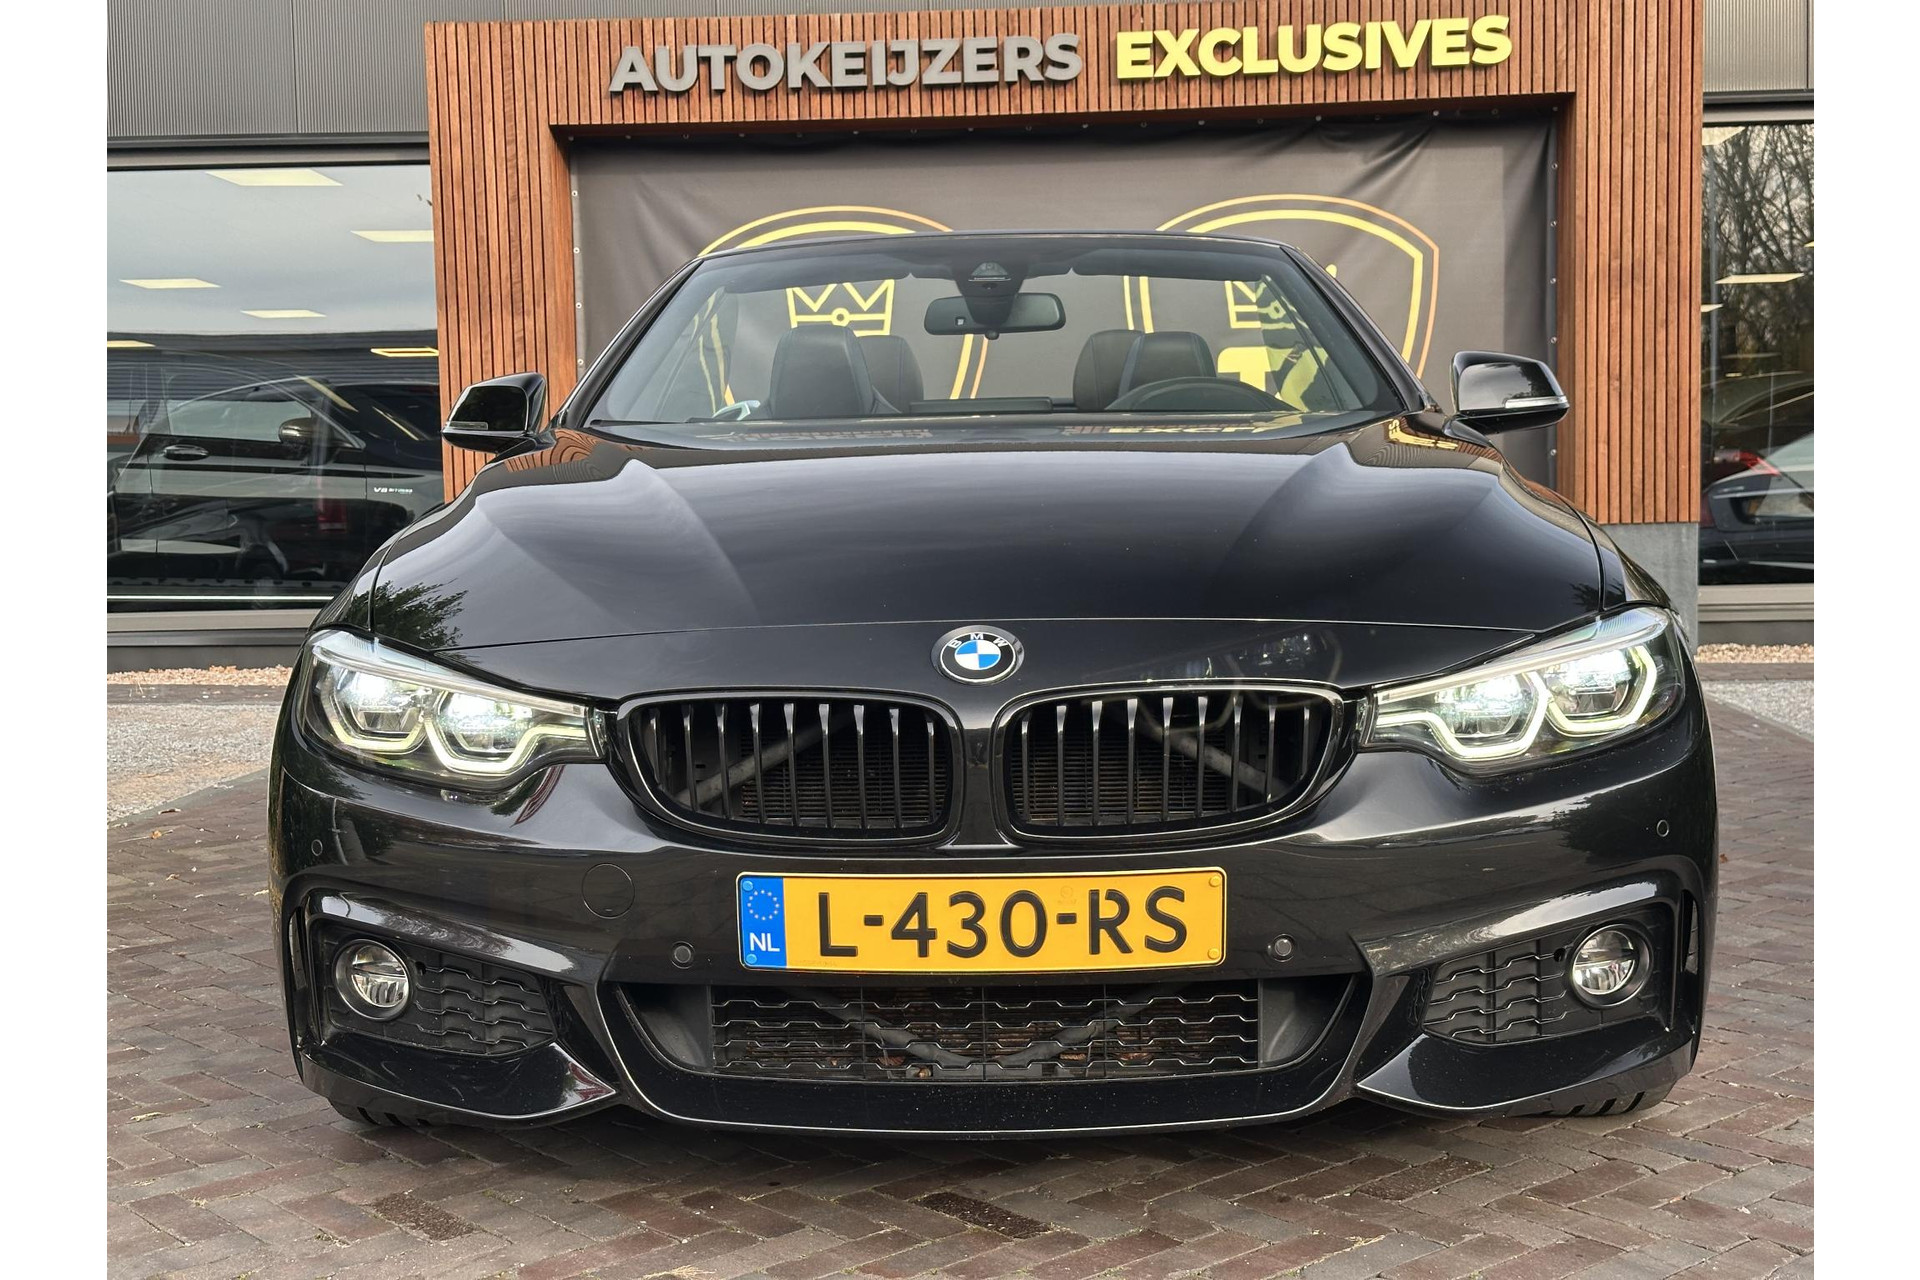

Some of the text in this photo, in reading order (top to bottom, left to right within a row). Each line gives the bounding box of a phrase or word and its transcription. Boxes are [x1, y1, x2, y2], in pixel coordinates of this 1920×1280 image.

[608, 15, 1513, 94] AUTOKEIJZERS EXCLUSIVES
[947, 633, 1009, 649] BMW
[750, 932, 780, 953] NL
[818, 886, 1188, 958] L-430-RS
